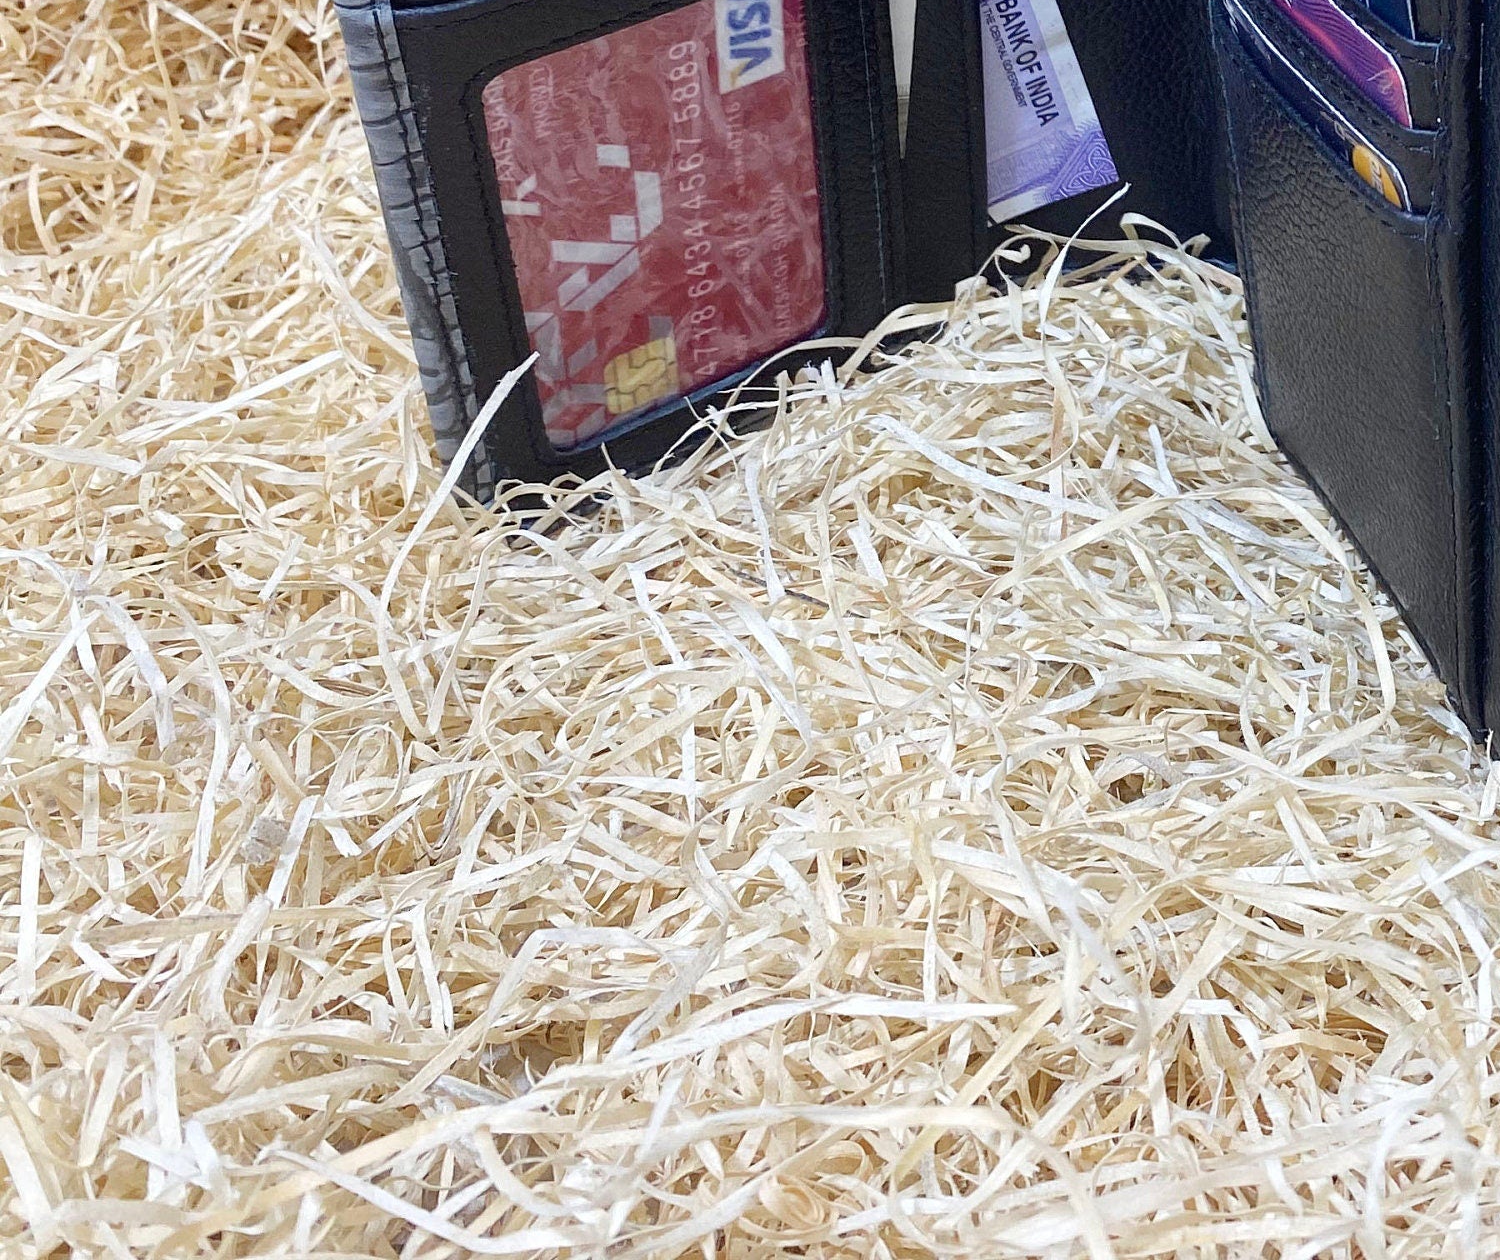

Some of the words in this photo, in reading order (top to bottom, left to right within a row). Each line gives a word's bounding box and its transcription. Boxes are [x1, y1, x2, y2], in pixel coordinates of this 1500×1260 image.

[669, 41, 700, 123] 5889
[988, 23, 1010, 61] CENTRAL
[1001, 60, 1028, 108] GOVERNMENT
[1016, 50, 1043, 75] OF
[1026, 75, 1060, 127] INDIA
[492, 137, 515, 181] AXIS
[675, 138, 712, 210] 4567
[693, 306, 719, 376] 4718
